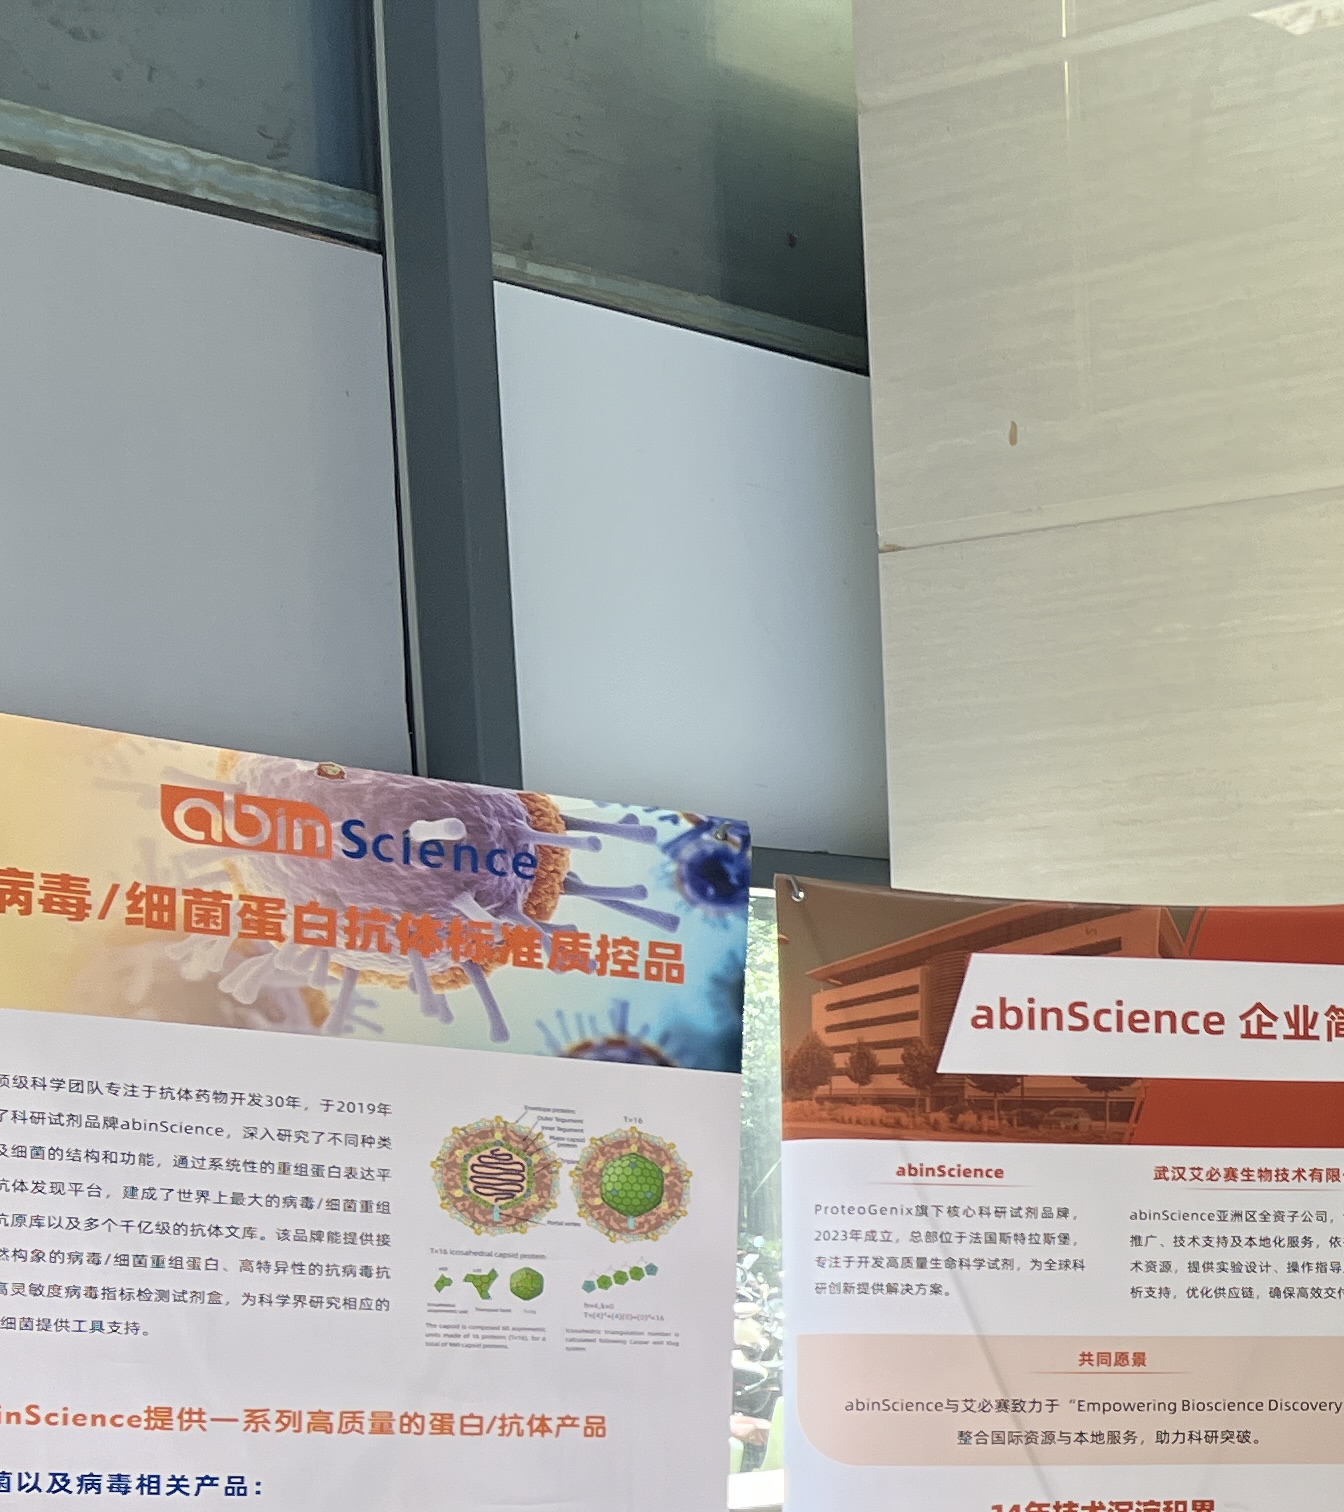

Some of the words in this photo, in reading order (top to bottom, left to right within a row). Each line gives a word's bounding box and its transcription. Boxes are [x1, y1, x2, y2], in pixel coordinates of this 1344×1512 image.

[0, 867, 686, 985] 病毒/细菌蛋白抗体标准质控品
[970, 997, 1226, 1036] abinScience
[895, 1163, 1005, 1180] abinScience
[1077, 1351, 1148, 1368] 共同愿景
[1181, 1399, 1265, 1414] Bioscience
